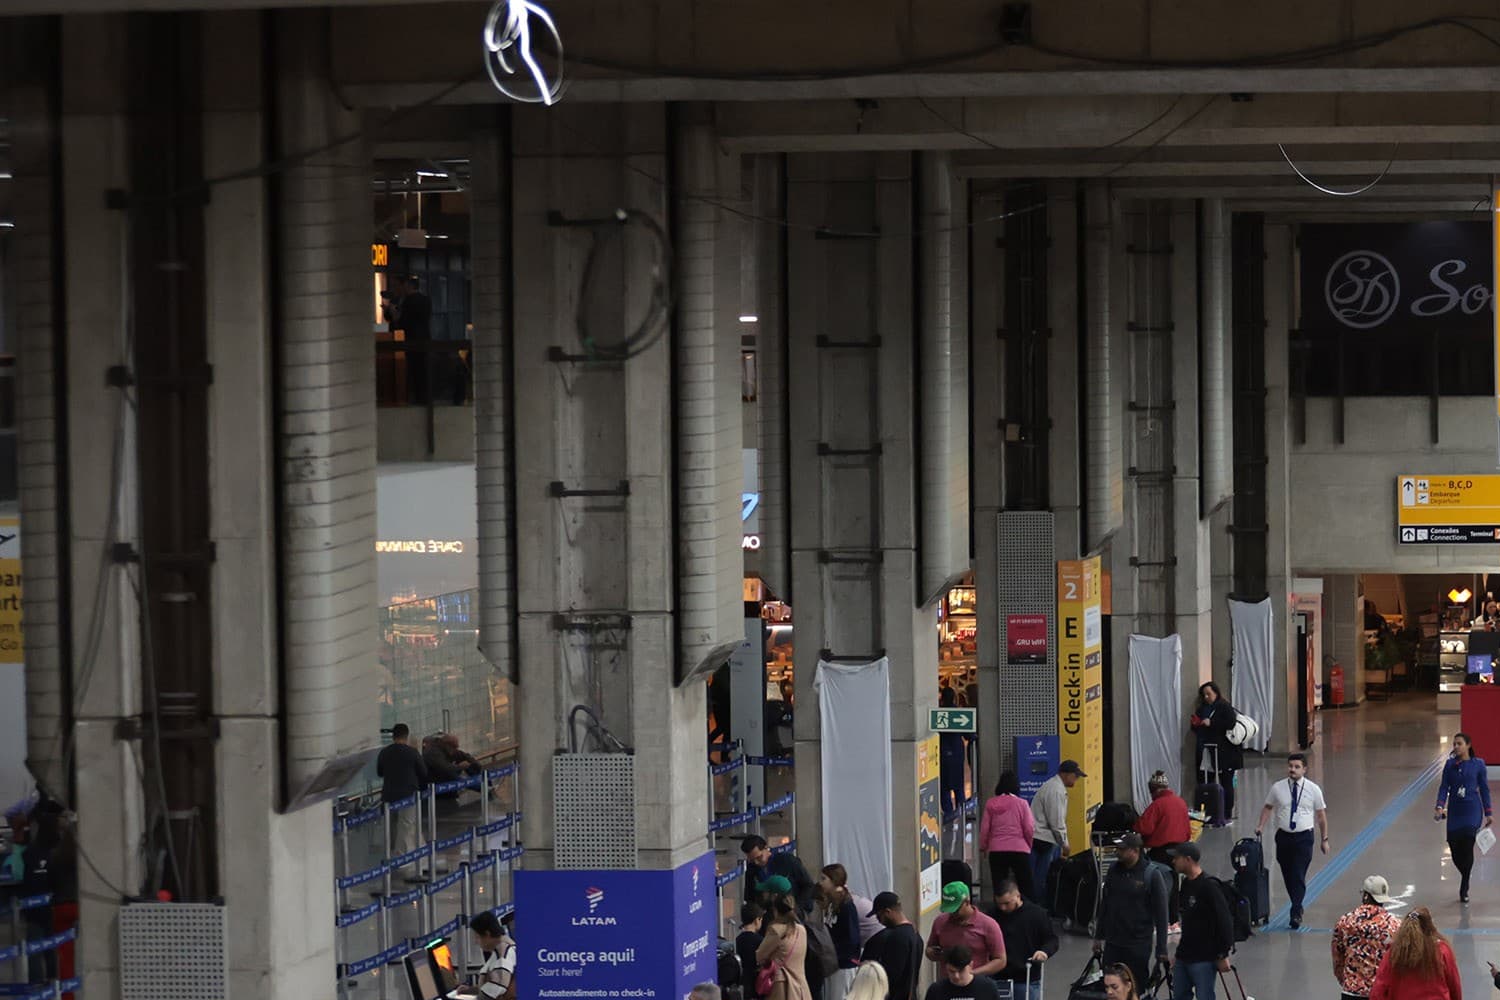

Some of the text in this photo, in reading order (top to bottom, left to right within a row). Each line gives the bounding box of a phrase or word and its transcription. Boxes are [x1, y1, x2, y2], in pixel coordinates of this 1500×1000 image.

[1410, 259, 1494, 316] So
[1448, 481, 1473, 490] B,C,D
[1065, 582, 1077, 599] 2
[1065, 617, 1077, 638] E
[1064, 652, 1080, 735] Check-in
[572, 917, 617, 926] LATAM
[537, 948, 635, 967] Começa aqui!
[538, 968, 583, 977] Start here!
[538, 989, 608, 998] Autoatendimento
[620, 989, 655, 998] check-in
